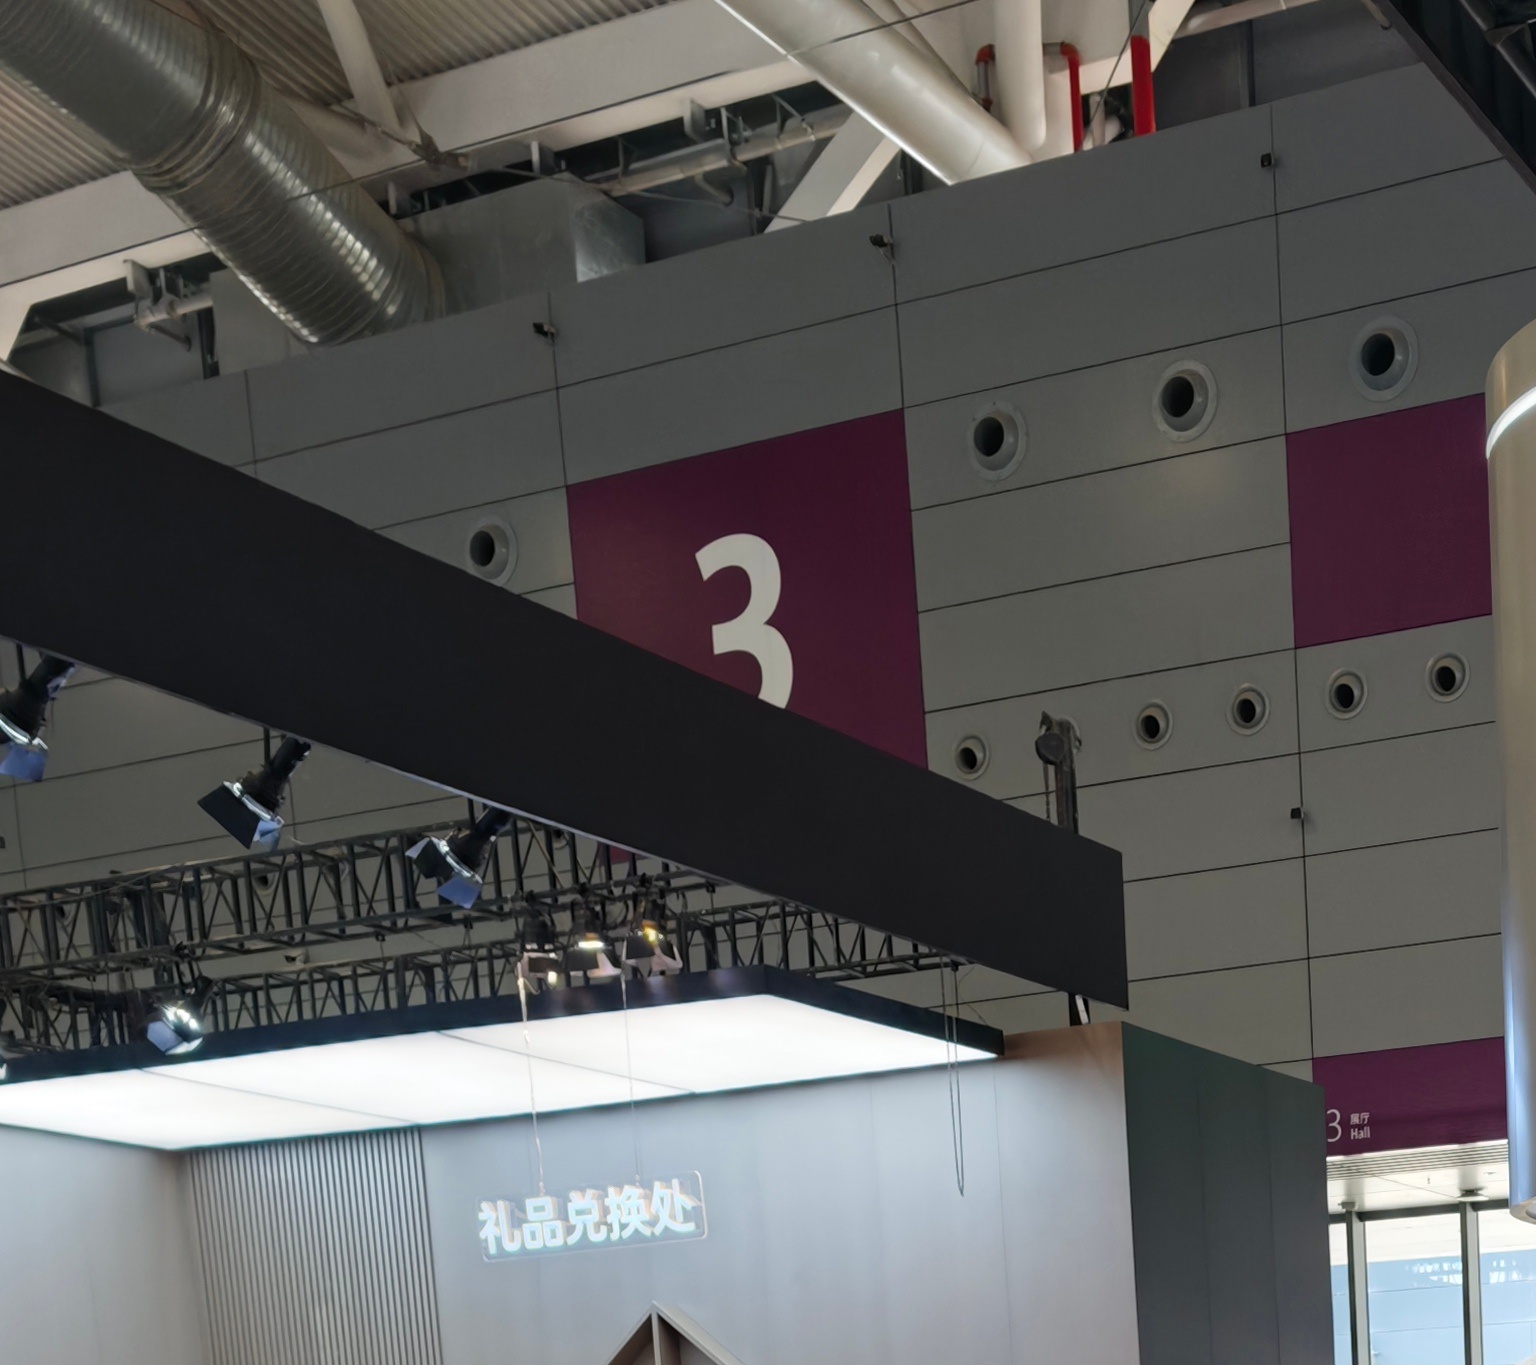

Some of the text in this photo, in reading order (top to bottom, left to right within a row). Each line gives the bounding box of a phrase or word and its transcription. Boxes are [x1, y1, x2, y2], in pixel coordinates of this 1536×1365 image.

[694, 532, 794, 710] 3
[1326, 1108, 1342, 1143] 3
[1350, 1112, 1370, 1125] 展厅
[1350, 1126, 1371, 1140] Hall
[478, 1177, 696, 1255] 礼品兑换处
